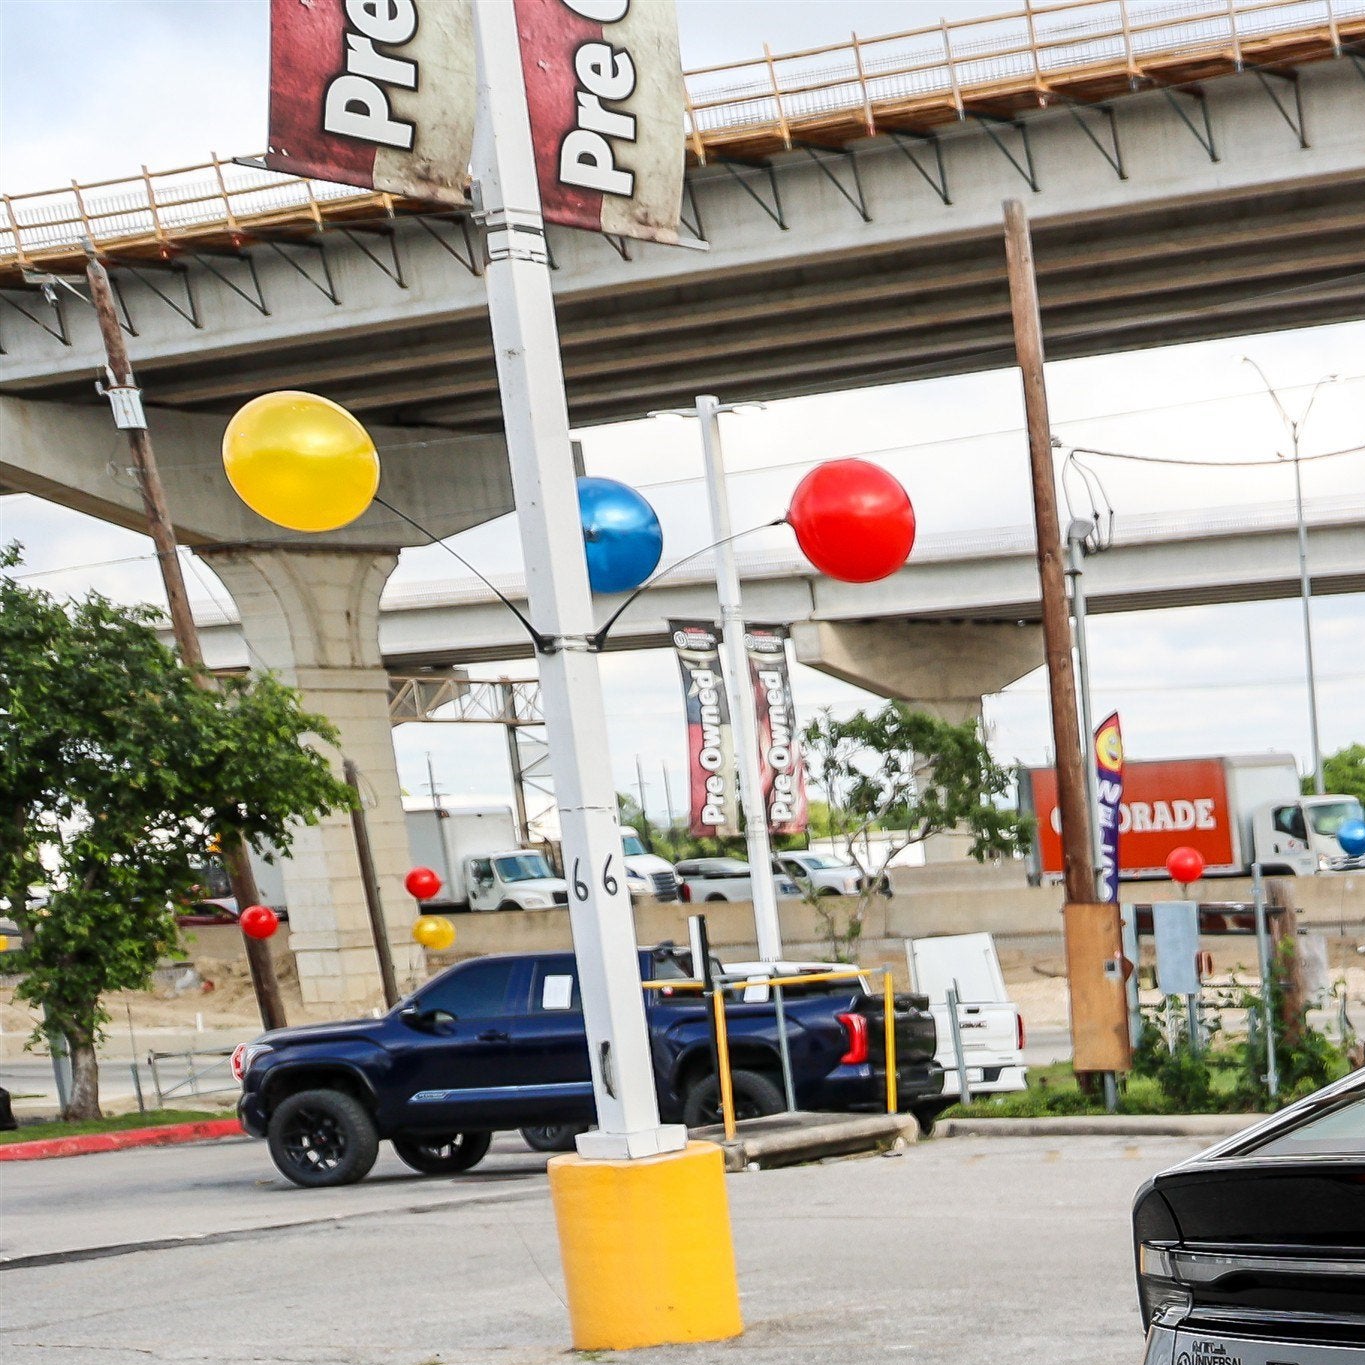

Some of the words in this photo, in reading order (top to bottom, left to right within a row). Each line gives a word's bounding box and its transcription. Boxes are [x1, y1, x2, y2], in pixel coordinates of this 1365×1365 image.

[324, 0, 417, 149] Pre
[560, 42, 636, 197] Pre
[691, 670, 722, 771] Owned
[759, 671, 791, 770] Owned
[702, 774, 725, 826] Pre
[770, 774, 794, 824] Pre
